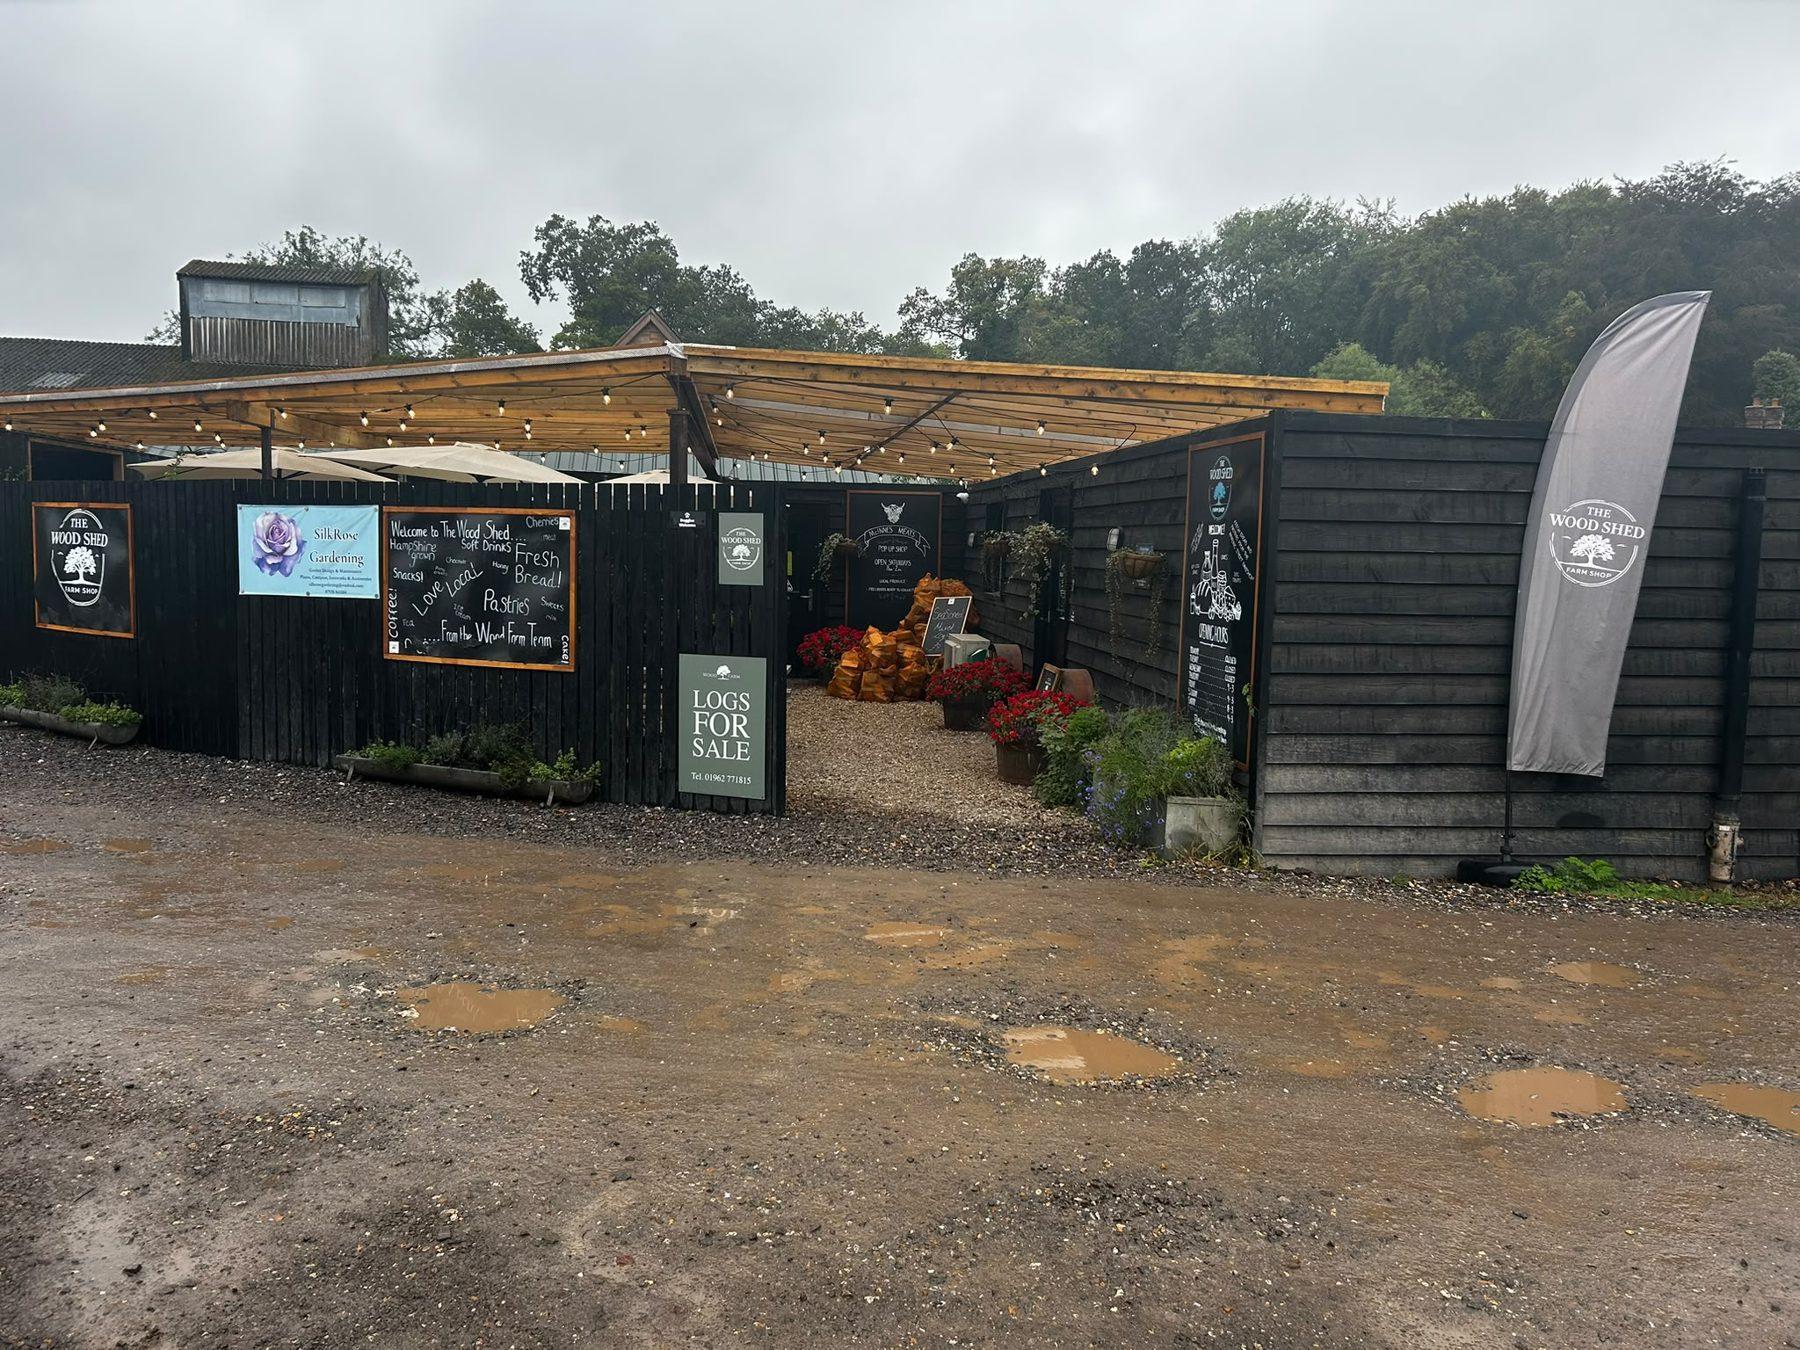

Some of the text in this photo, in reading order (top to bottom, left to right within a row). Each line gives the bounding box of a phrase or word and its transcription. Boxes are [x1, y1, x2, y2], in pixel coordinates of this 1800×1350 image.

[1587, 506, 1612, 518] THE
[70, 518, 88, 528] THE
[391, 520, 428, 538] Welcome
[430, 525, 439, 538] to
[440, 520, 456, 538] The
[456, 519, 480, 539] Wood
[1549, 513, 1646, 539] WOOD SHED
[51, 531, 108, 547] WOOD SHED
[314, 527, 358, 540] SilkRose
[461, 538, 512, 552] Soft Drinks
[310, 550, 364, 568] Gardening
[515, 542, 560, 568] Fresh
[492, 560, 510, 574] Honey
[515, 564, 562, 588] Bread!
[1566, 567, 1612, 578] FARM SHOP
[412, 581, 444, 616] Love
[484, 588, 530, 616] Pastries
[693, 690, 750, 712] LOGS
[693, 710, 750, 738] FOR
[692, 738, 750, 760] SALE
[691, 772, 752, 784] Tel. 01962 771815
